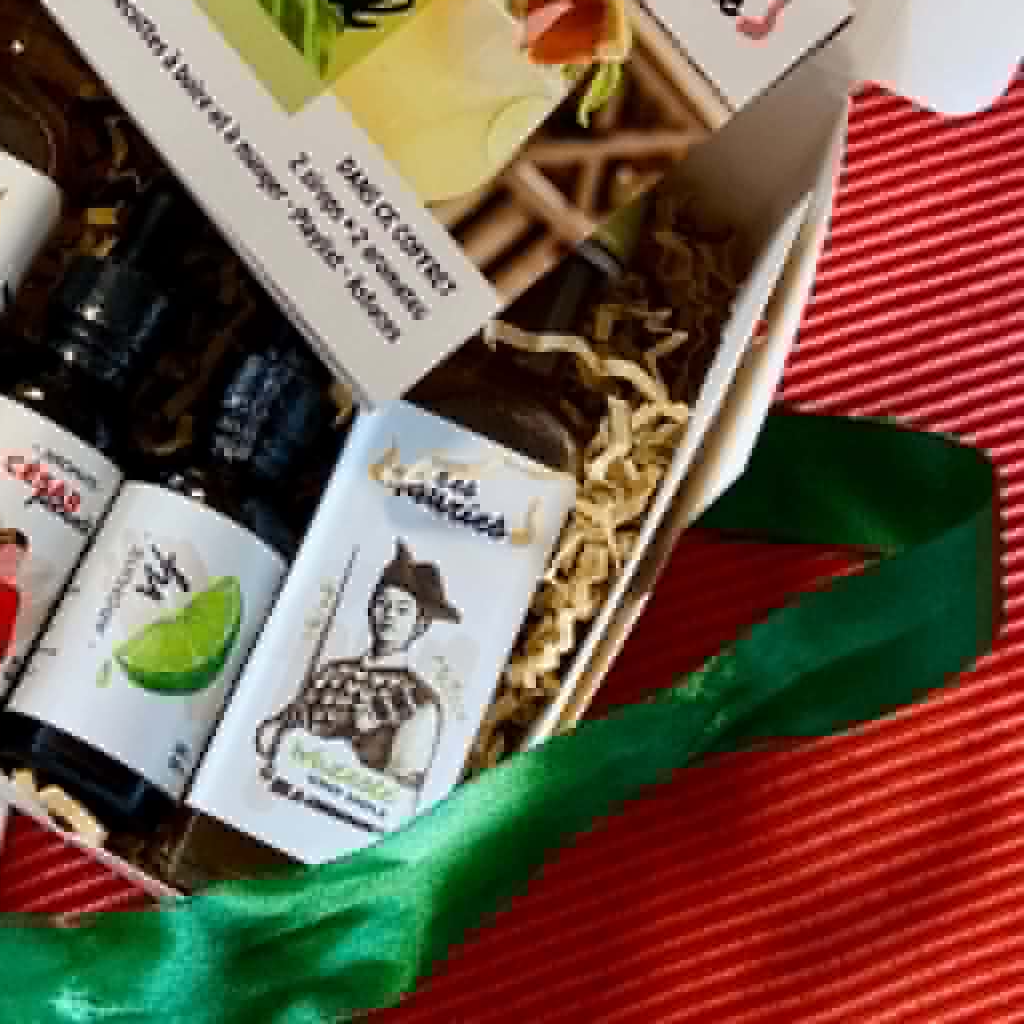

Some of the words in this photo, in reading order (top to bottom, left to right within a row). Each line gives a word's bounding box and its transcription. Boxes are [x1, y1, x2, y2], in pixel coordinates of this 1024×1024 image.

[288, 152, 311, 175] 2
[351, 227, 369, 248] 2
[336, 152, 380, 205] DANS
[374, 201, 400, 231] CE
[391, 225, 456, 296] COFFRET
[433, 471, 479, 504] Les
